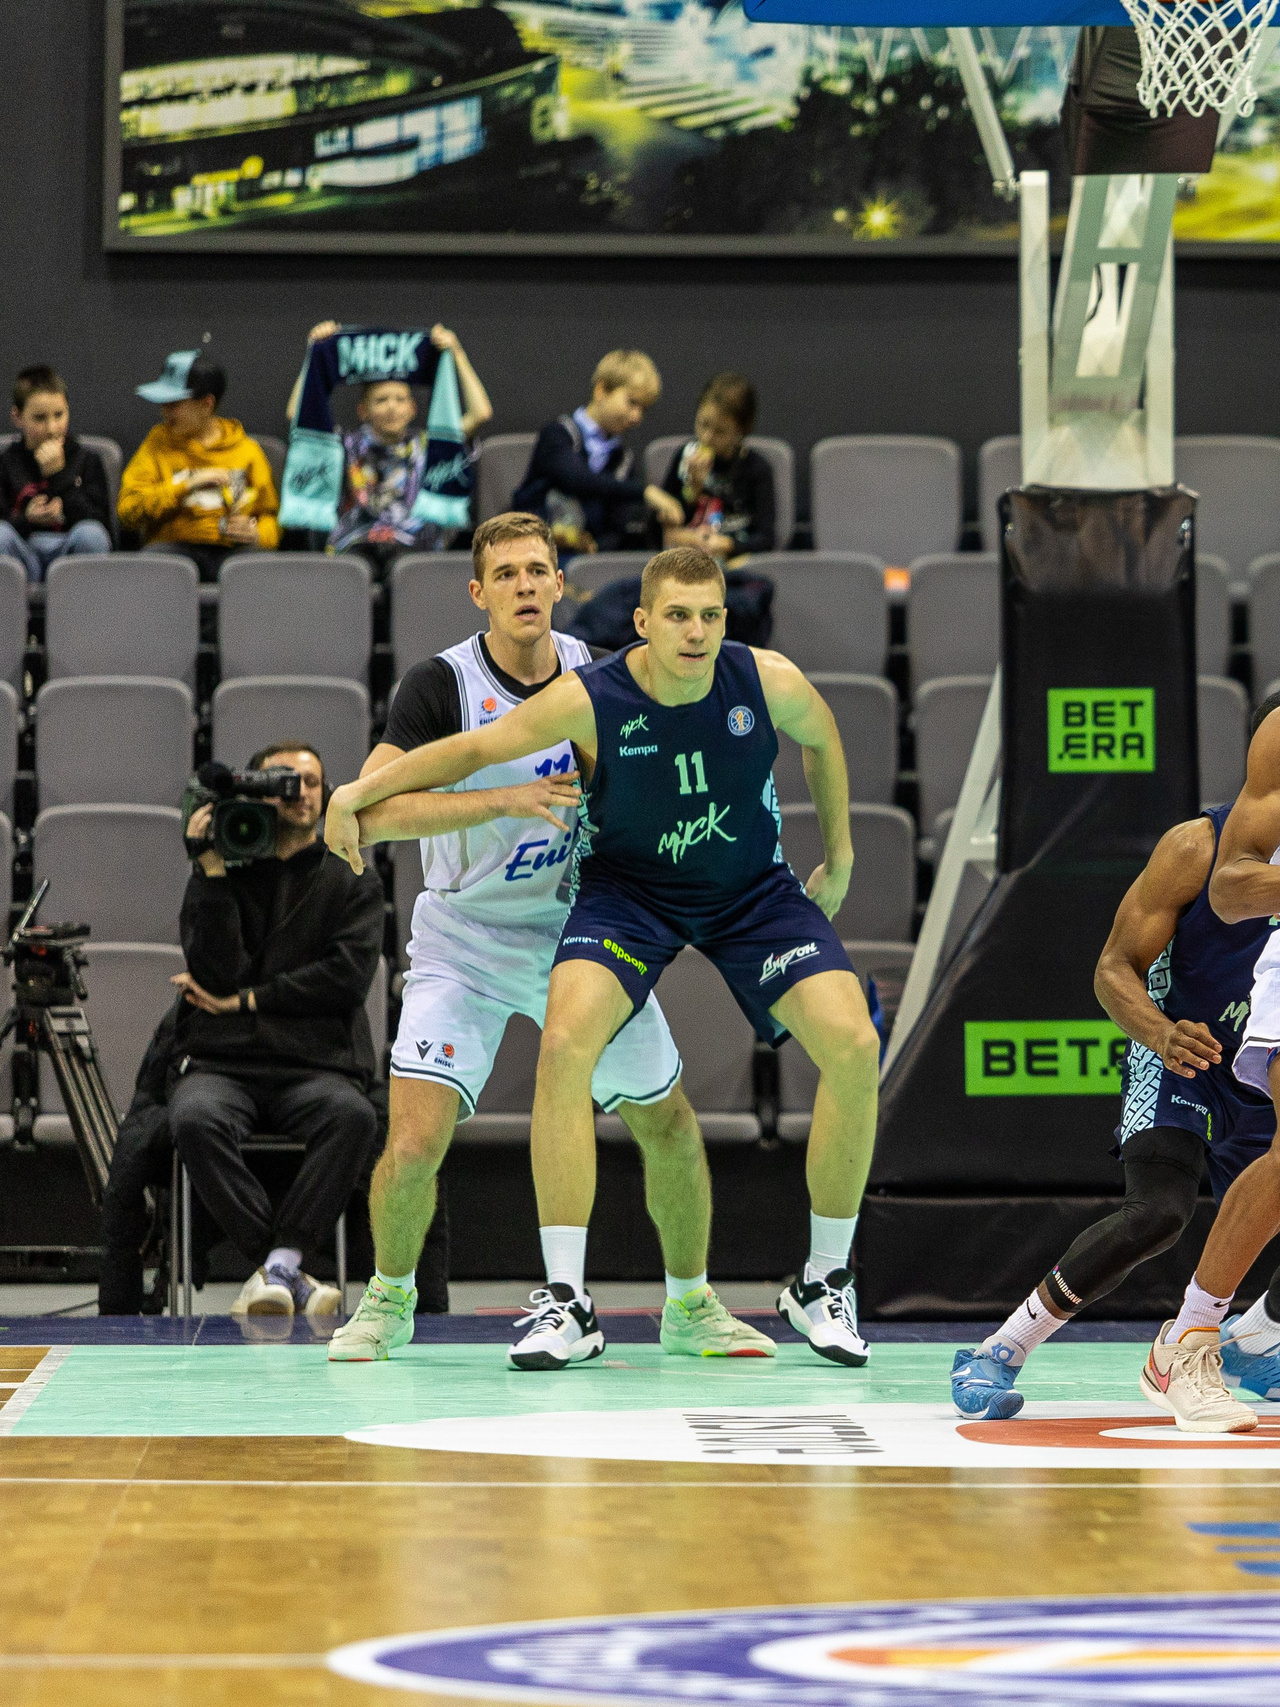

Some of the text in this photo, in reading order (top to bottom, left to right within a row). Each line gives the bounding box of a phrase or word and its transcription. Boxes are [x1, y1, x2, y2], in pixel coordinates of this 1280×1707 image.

[1064, 701, 1143, 727] BET
[619, 744, 658, 757] Kempa
[675, 751, 708, 795] 11
[983, 1038, 1126, 1076] BET.
